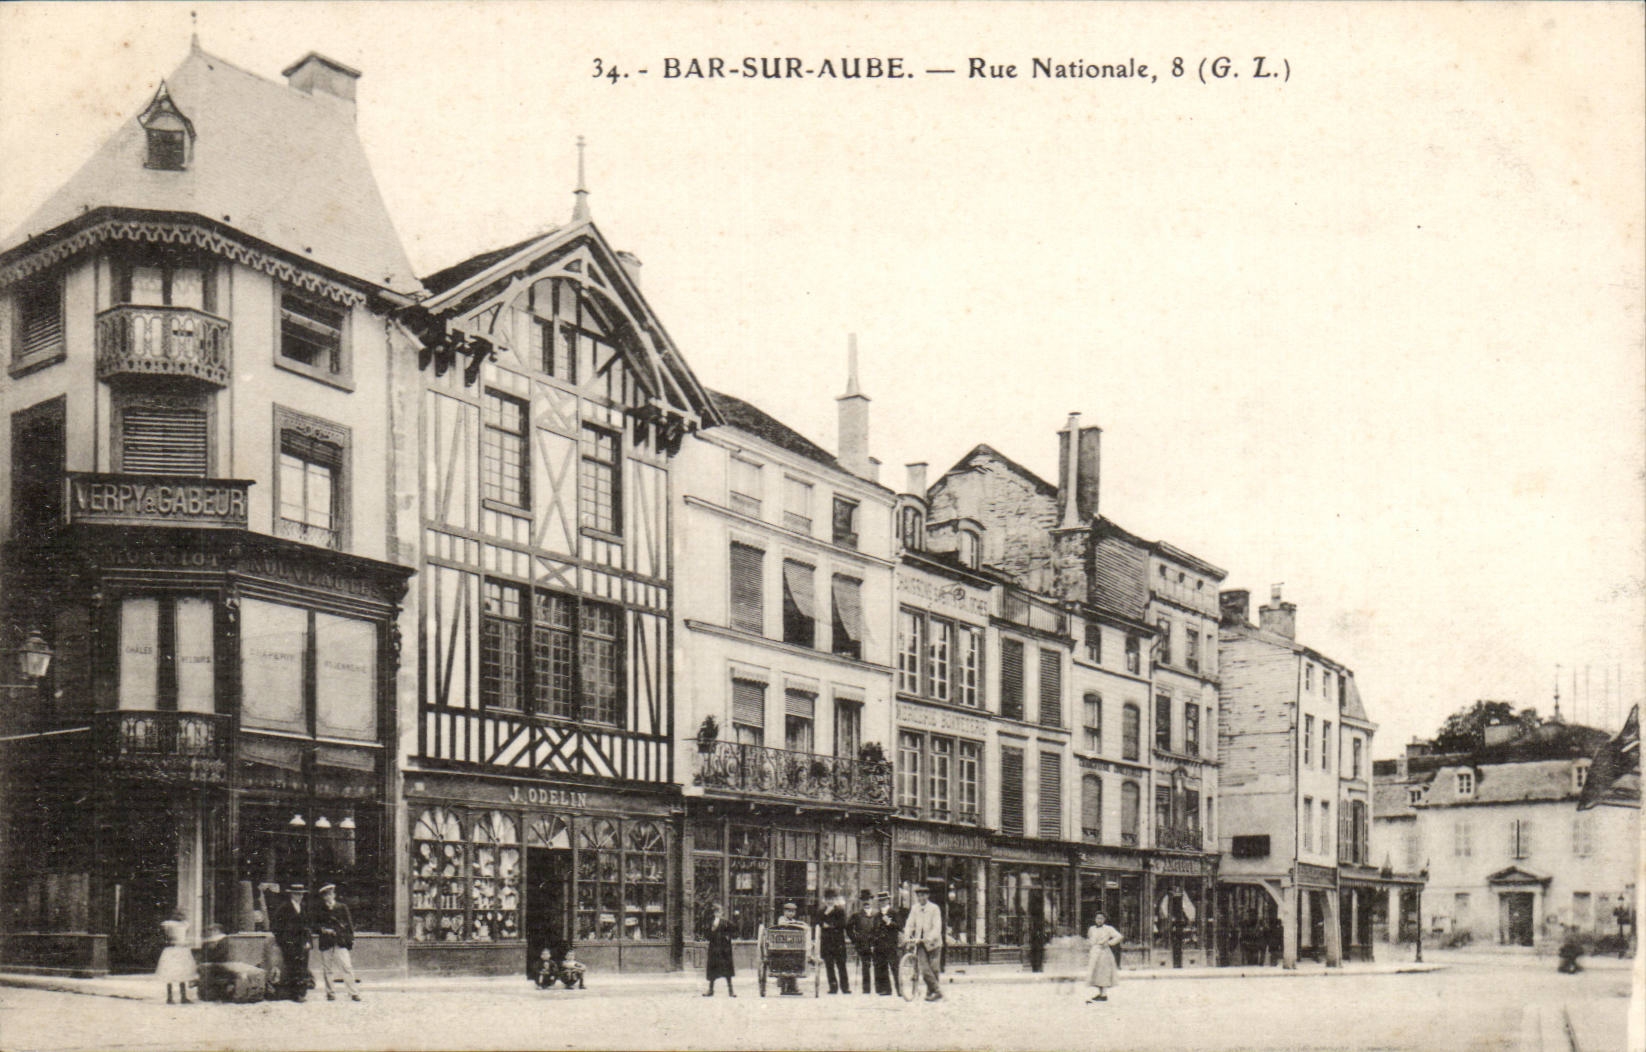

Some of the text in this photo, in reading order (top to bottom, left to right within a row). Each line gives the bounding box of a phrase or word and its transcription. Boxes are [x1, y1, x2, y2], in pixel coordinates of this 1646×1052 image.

[75, 481, 146, 512] VERPY
[158, 486, 245, 516] GABEUR
[528, 787, 587, 808] ODELIN
